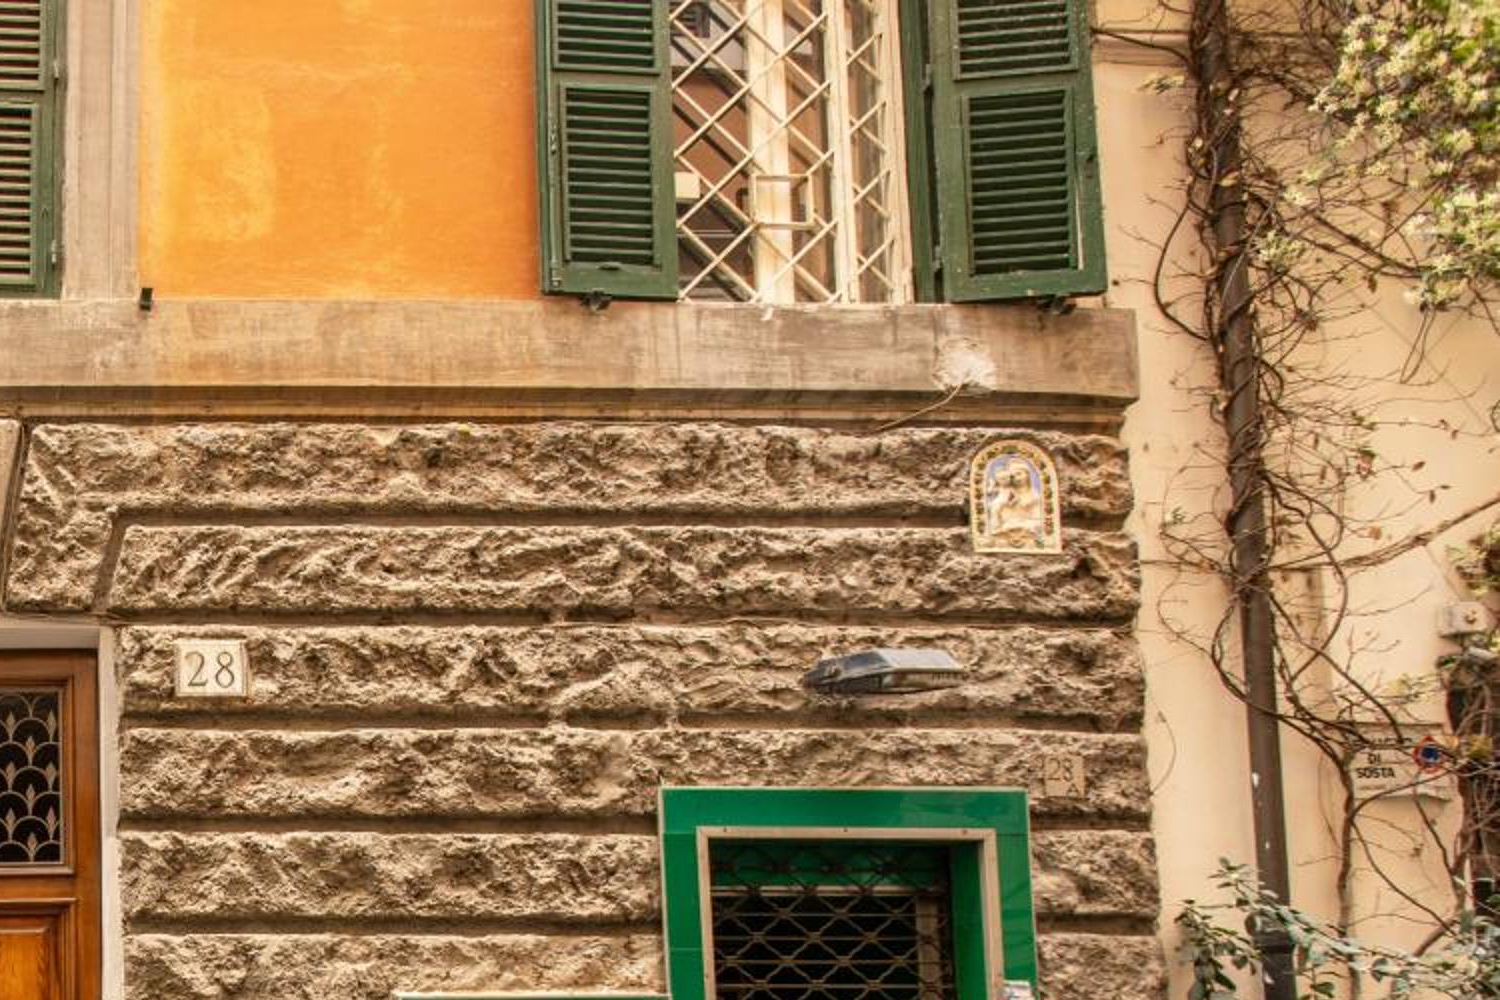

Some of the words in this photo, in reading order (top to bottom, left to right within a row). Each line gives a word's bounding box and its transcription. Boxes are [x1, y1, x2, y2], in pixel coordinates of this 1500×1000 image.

[184, 650, 235, 689] 28
[1049, 757, 1074, 782] 28
[1355, 767, 1396, 779] SOSTA
